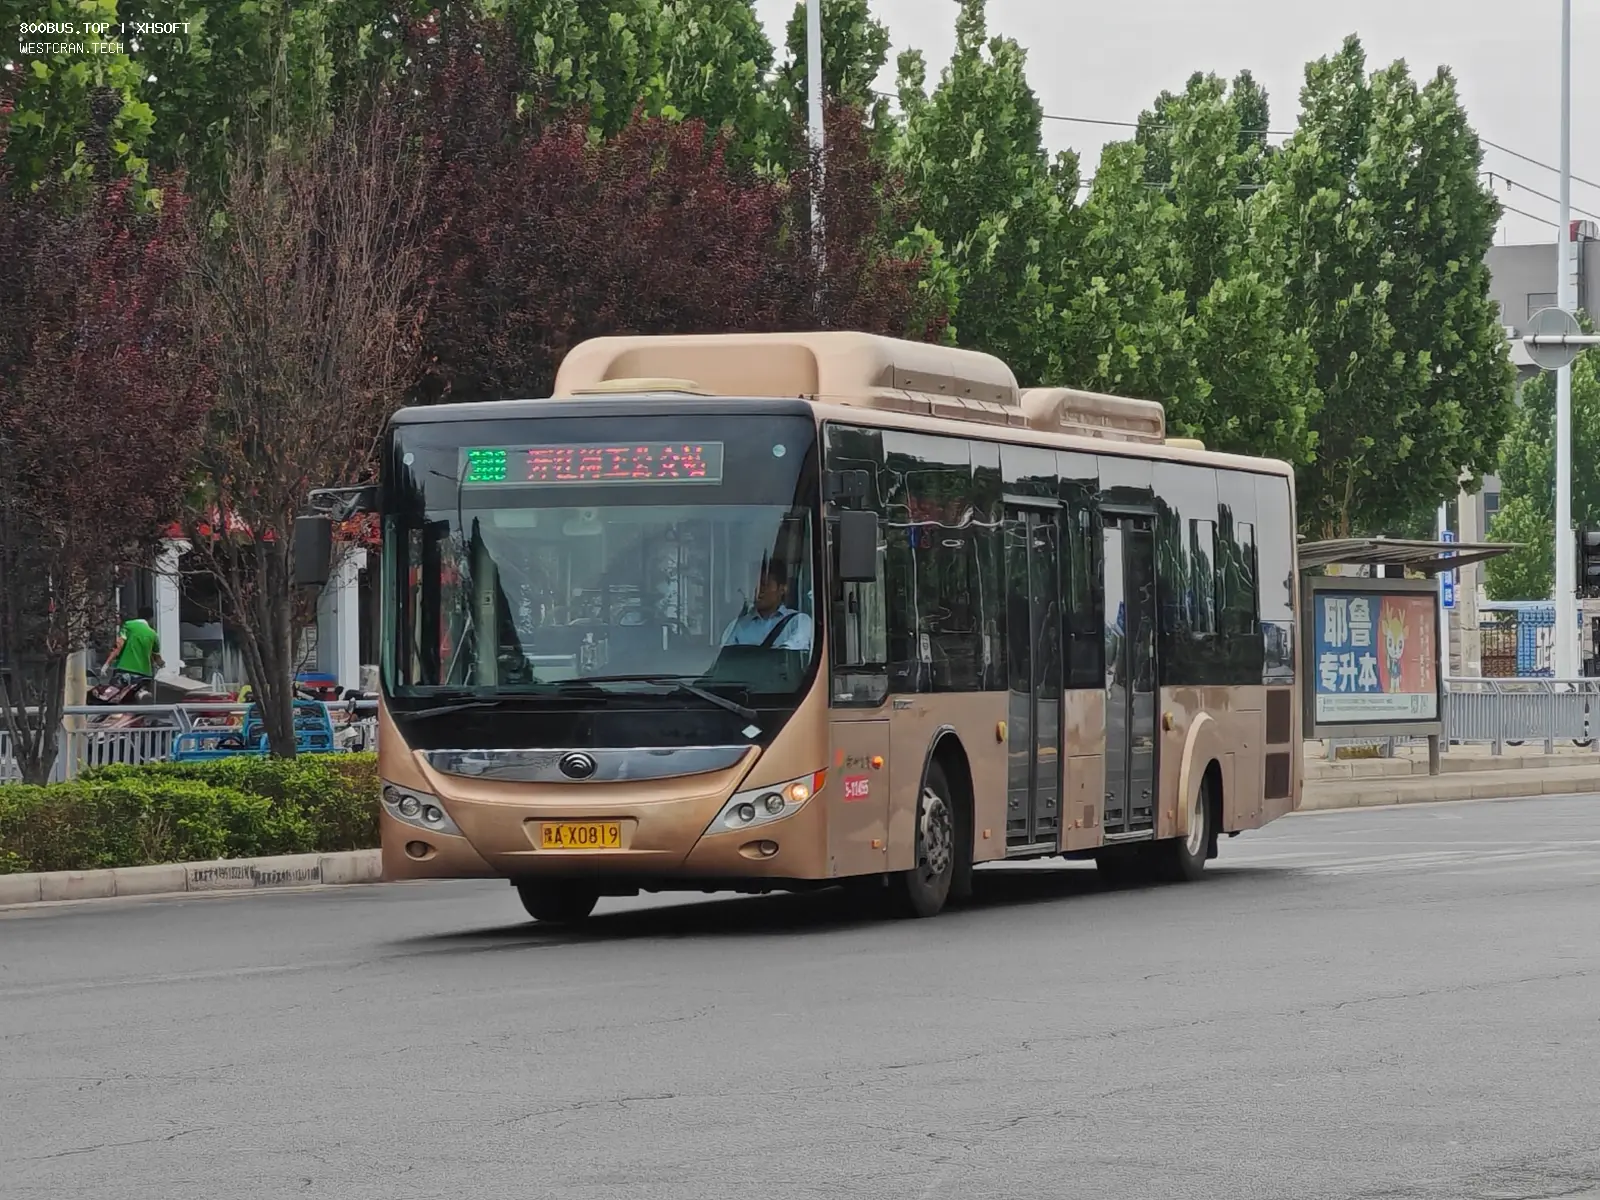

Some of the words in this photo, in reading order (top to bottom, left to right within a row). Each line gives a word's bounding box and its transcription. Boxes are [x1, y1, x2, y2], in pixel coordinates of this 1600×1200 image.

[1323, 597, 1372, 648] 耶鲁
[1319, 651, 1378, 692] 专升本
